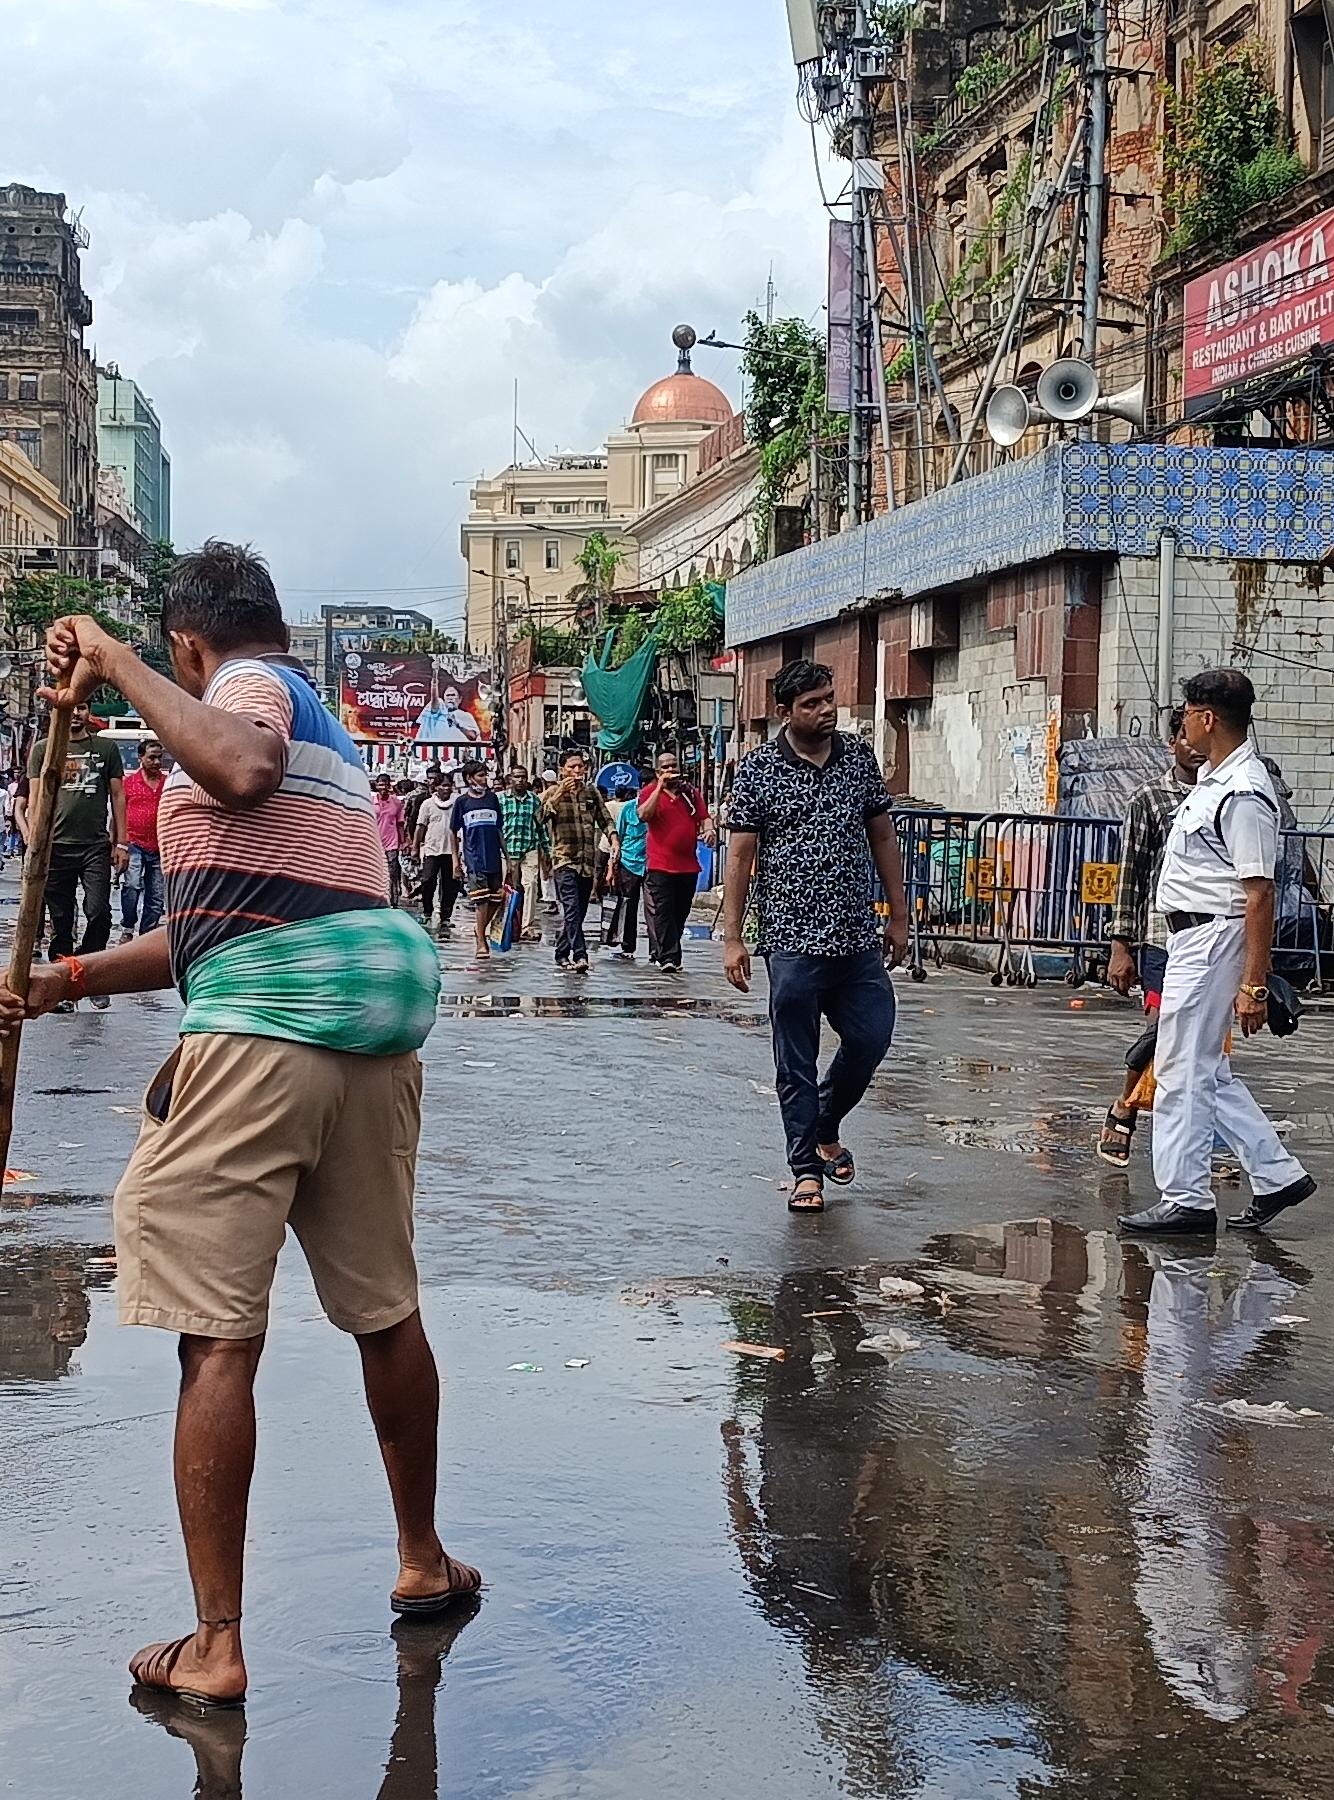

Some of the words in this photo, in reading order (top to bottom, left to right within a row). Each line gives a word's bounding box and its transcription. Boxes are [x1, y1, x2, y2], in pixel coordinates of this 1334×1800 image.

[1204, 227, 1330, 337] ASHOKA
[1192, 325, 1256, 370] RESTAURANT
[1259, 321, 1267, 342] &
[1269, 309, 1292, 339] BAR
[1211, 361, 1239, 385] INDIAN
[1240, 357, 1246, 374] &
[1247, 342, 1284, 371] CHINESE
[1285, 324, 1321, 355] CUISINE
